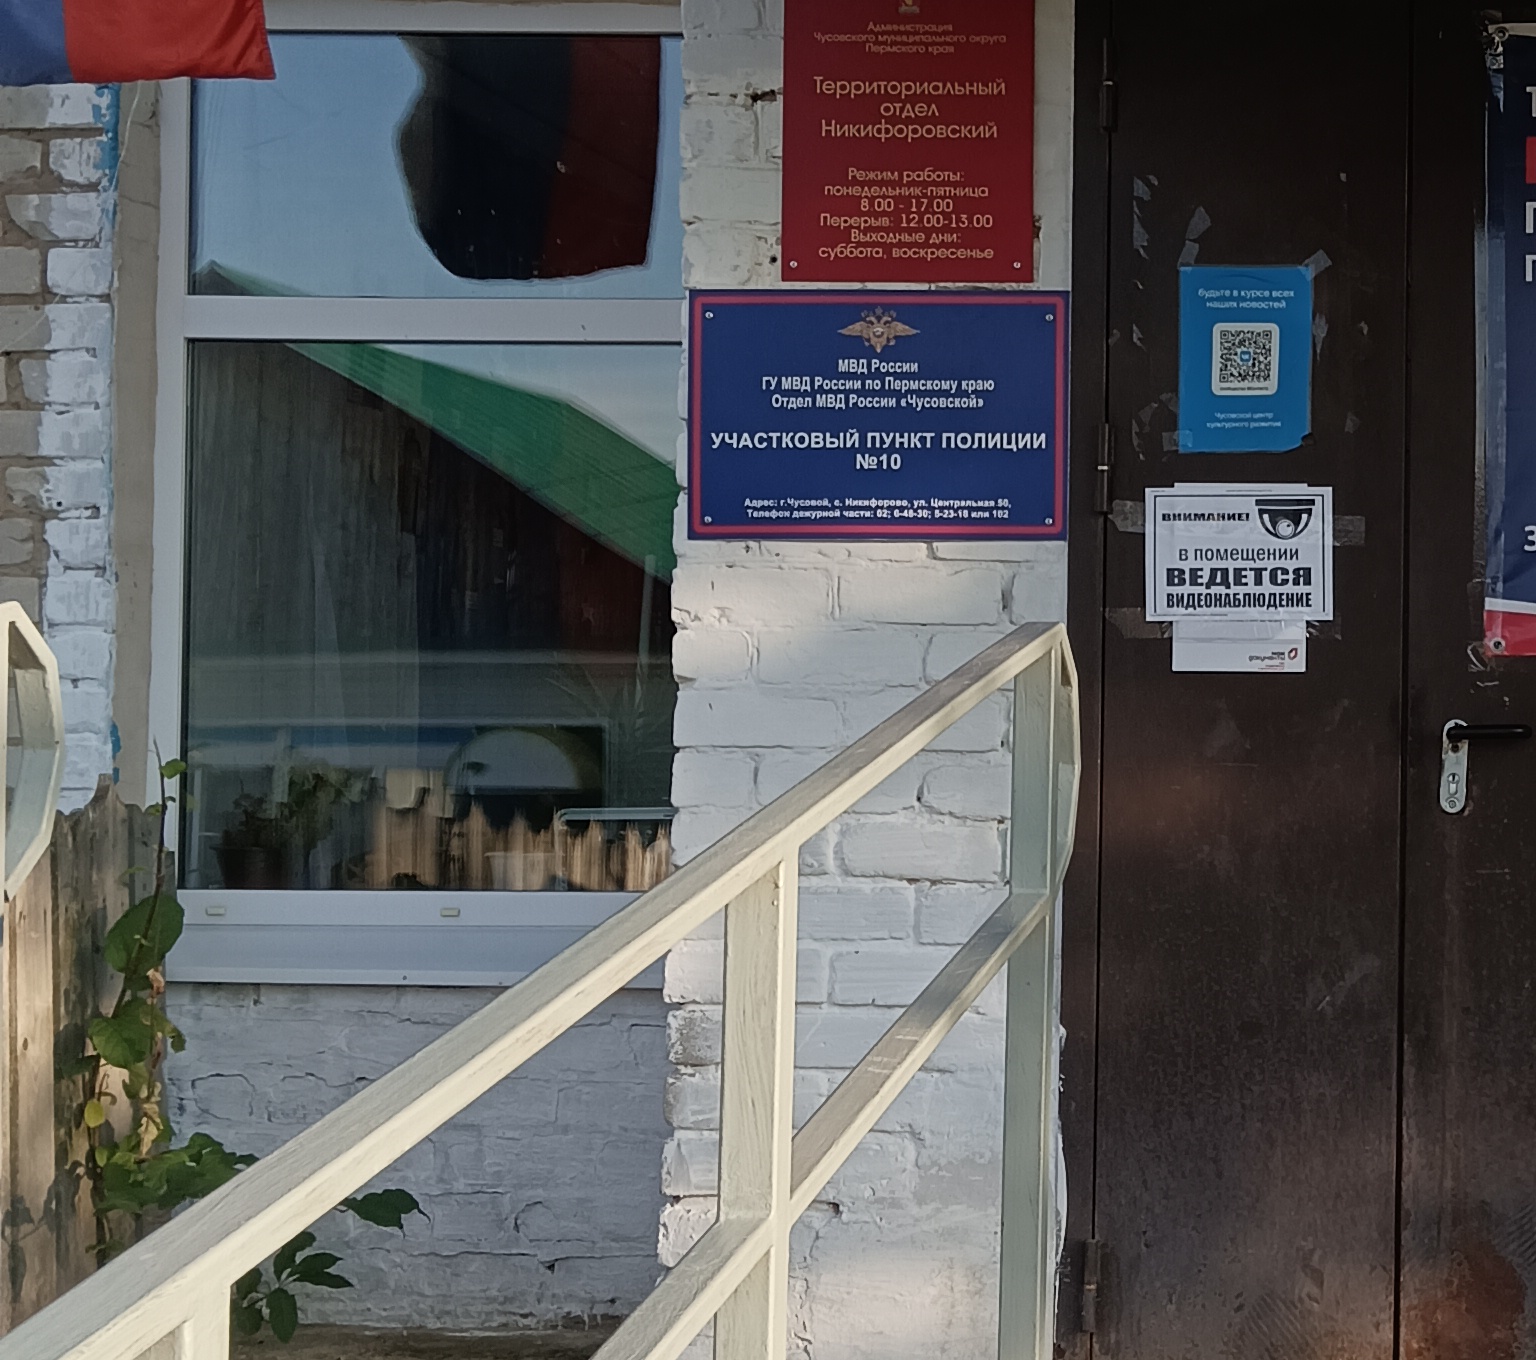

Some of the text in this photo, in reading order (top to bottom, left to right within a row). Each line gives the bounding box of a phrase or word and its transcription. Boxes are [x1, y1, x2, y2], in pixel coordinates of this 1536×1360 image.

[969, 35, 1006, 45] округа
[865, 43, 955, 54] Пермского края
[814, 76, 1005, 99] Территориальный
[881, 101, 939, 118] отдел
[821, 118, 998, 142] Никифоровский
[849, 167, 964, 183] Режим работы:
[825, 185, 988, 197] понедельник-пятница
[861, 199, 894, 211] 8.00
[911, 199, 953, 211] 17.00
[821, 214, 992, 229] Перерыв: 12.00-13.00
[851, 230, 961, 243] Выходные дни:
[819, 243, 994, 260] суббота, воскресенье
[1241, 290, 1270, 299] курсе
[1272, 290, 1295, 298] всех
[1239, 299, 1287, 309] новостей
[838, 359, 918, 374] МВД России
[762, 377, 995, 393] ГУ МВД России по Пермскому краю
[772, 393, 984, 409] Отдел МВД России «Чусовской»
[711, 429, 1045, 451] УЧАСТКОВЫЙ ПУНКТ ПОЛИЦИИ
[856, 454, 901, 469] №10
[913, 500, 928, 509] ул.
[1162, 513, 1249, 521] ВНИМАНИЕ!
[1179, 548, 1298, 563] в помещении
[1166, 567, 1311, 589] ВЕДЕТСЯ
[1167, 593, 1312, 610] ВИДЕОНАБЛЮДЕНИЕ
